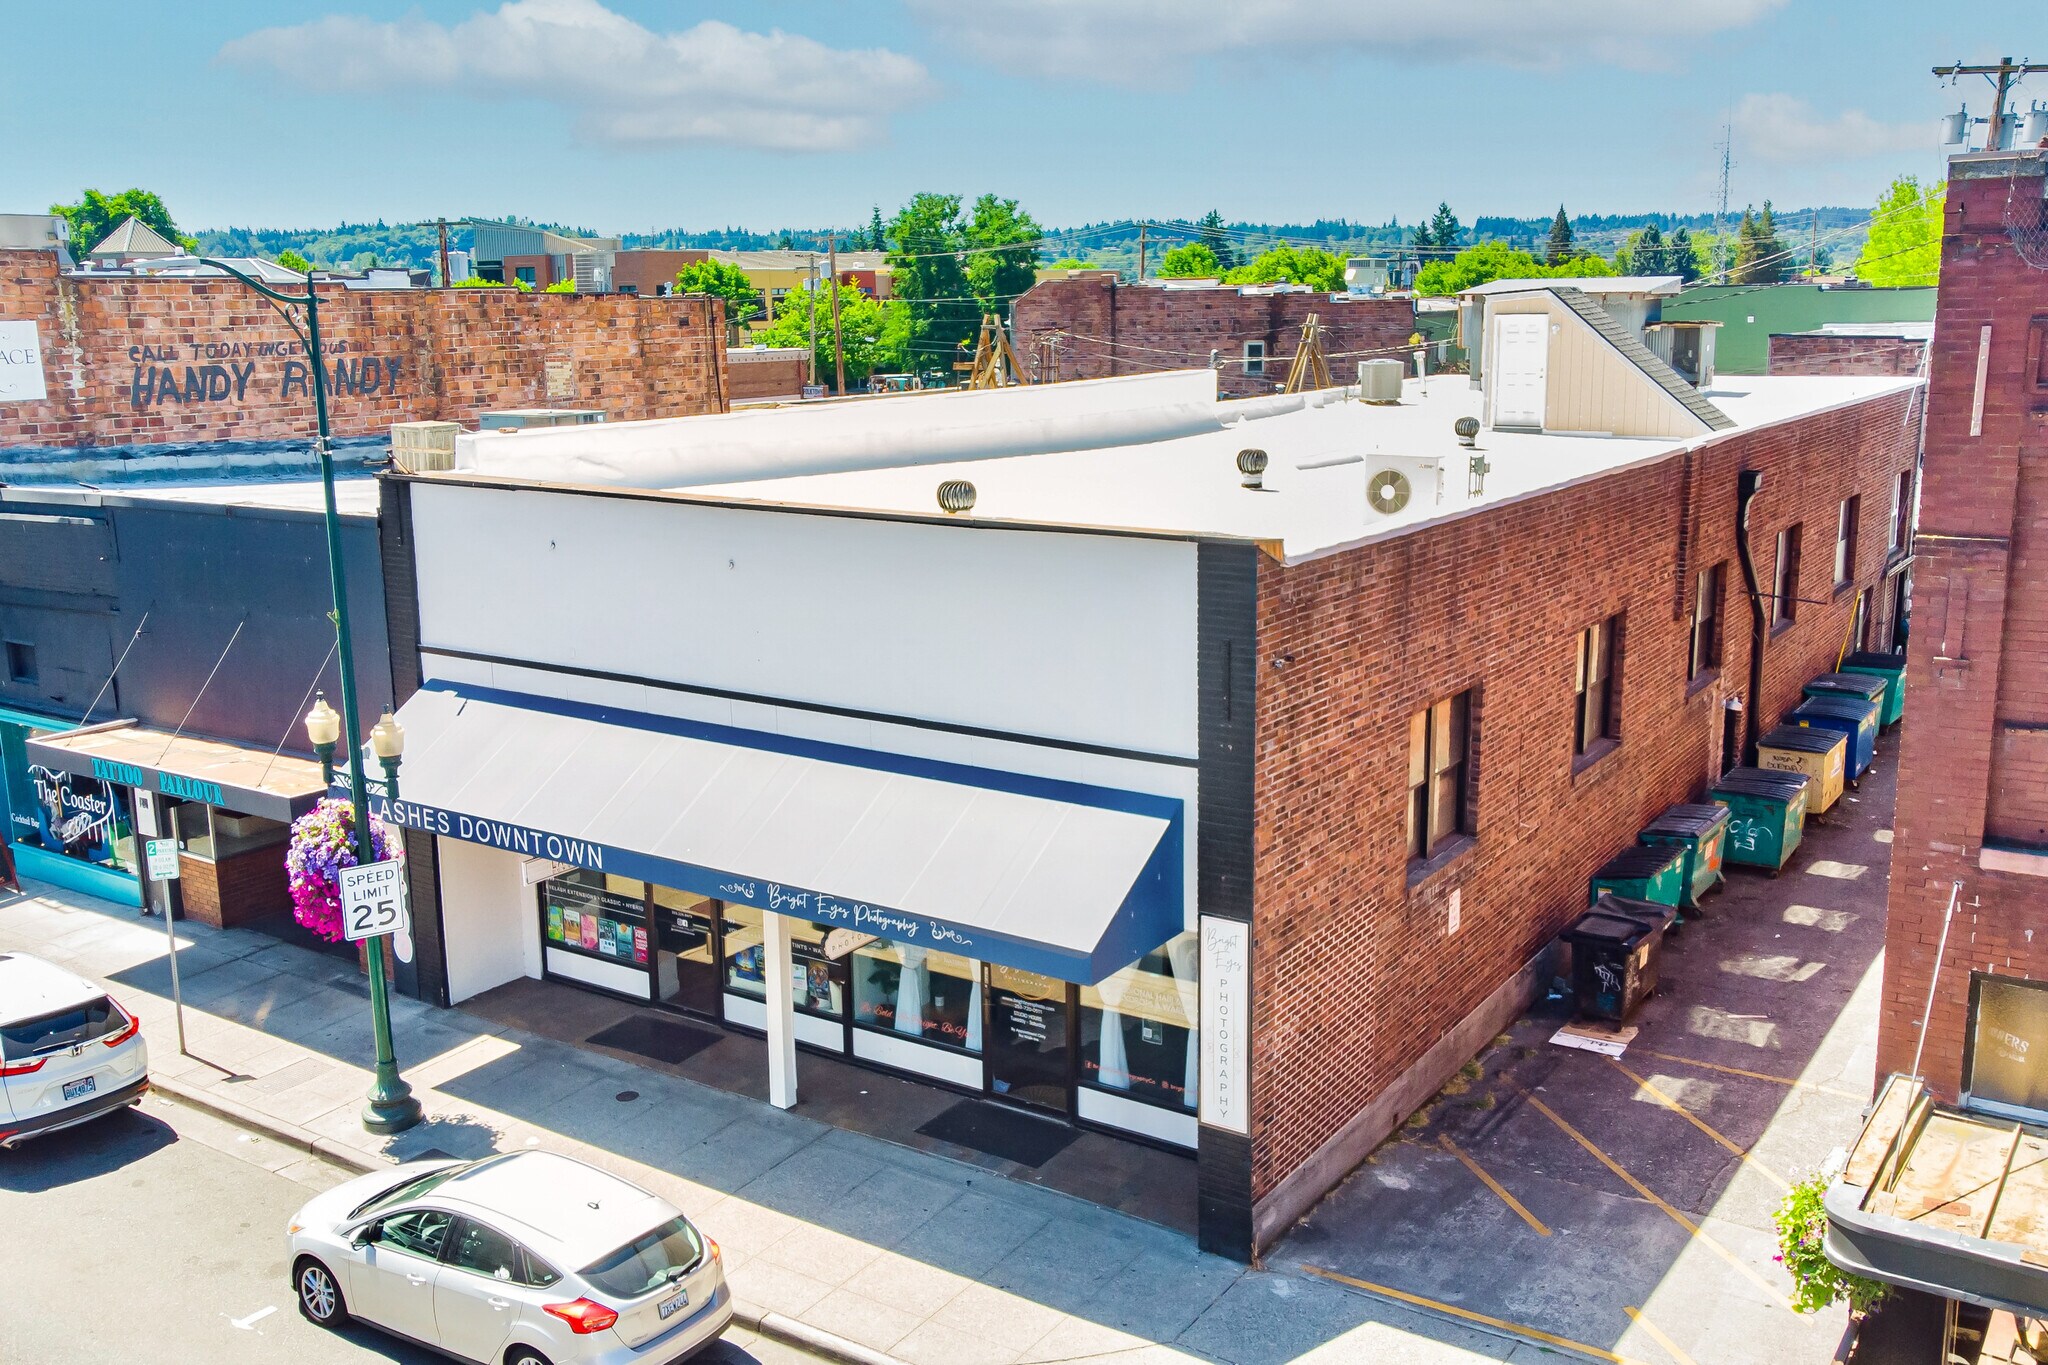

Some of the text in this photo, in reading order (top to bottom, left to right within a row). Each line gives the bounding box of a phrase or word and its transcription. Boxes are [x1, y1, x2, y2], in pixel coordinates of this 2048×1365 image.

[128, 340, 349, 363] CALL TODAY INGEOUS
[131, 355, 403, 406] HANDY RANDY
[91, 757, 225, 806] TATTOO PARLOUR
[34, 779, 107, 815] The Coaster
[11, 812, 31, 827] Cocktail
[148, 843, 156, 855] 2
[459, 815, 604, 870] DOWNTOWN
[347, 869, 394, 887] SPEED
[353, 885, 389, 901] LIMIT
[567, 888, 597, 901] EXTENSIONS
[601, 896, 621, 907] CLASSIC
[625, 903, 644, 912] HYBRID
[352, 899, 396, 931] 25
[767, 883, 919, 938] Bright Eyes Photography
[792, 942, 807, 951] TINTS
[1205, 926, 1239, 949] Bright
[1213, 949, 1242, 972] Eyes
[1219, 978, 1229, 1119] PHOTOGRAPHY
